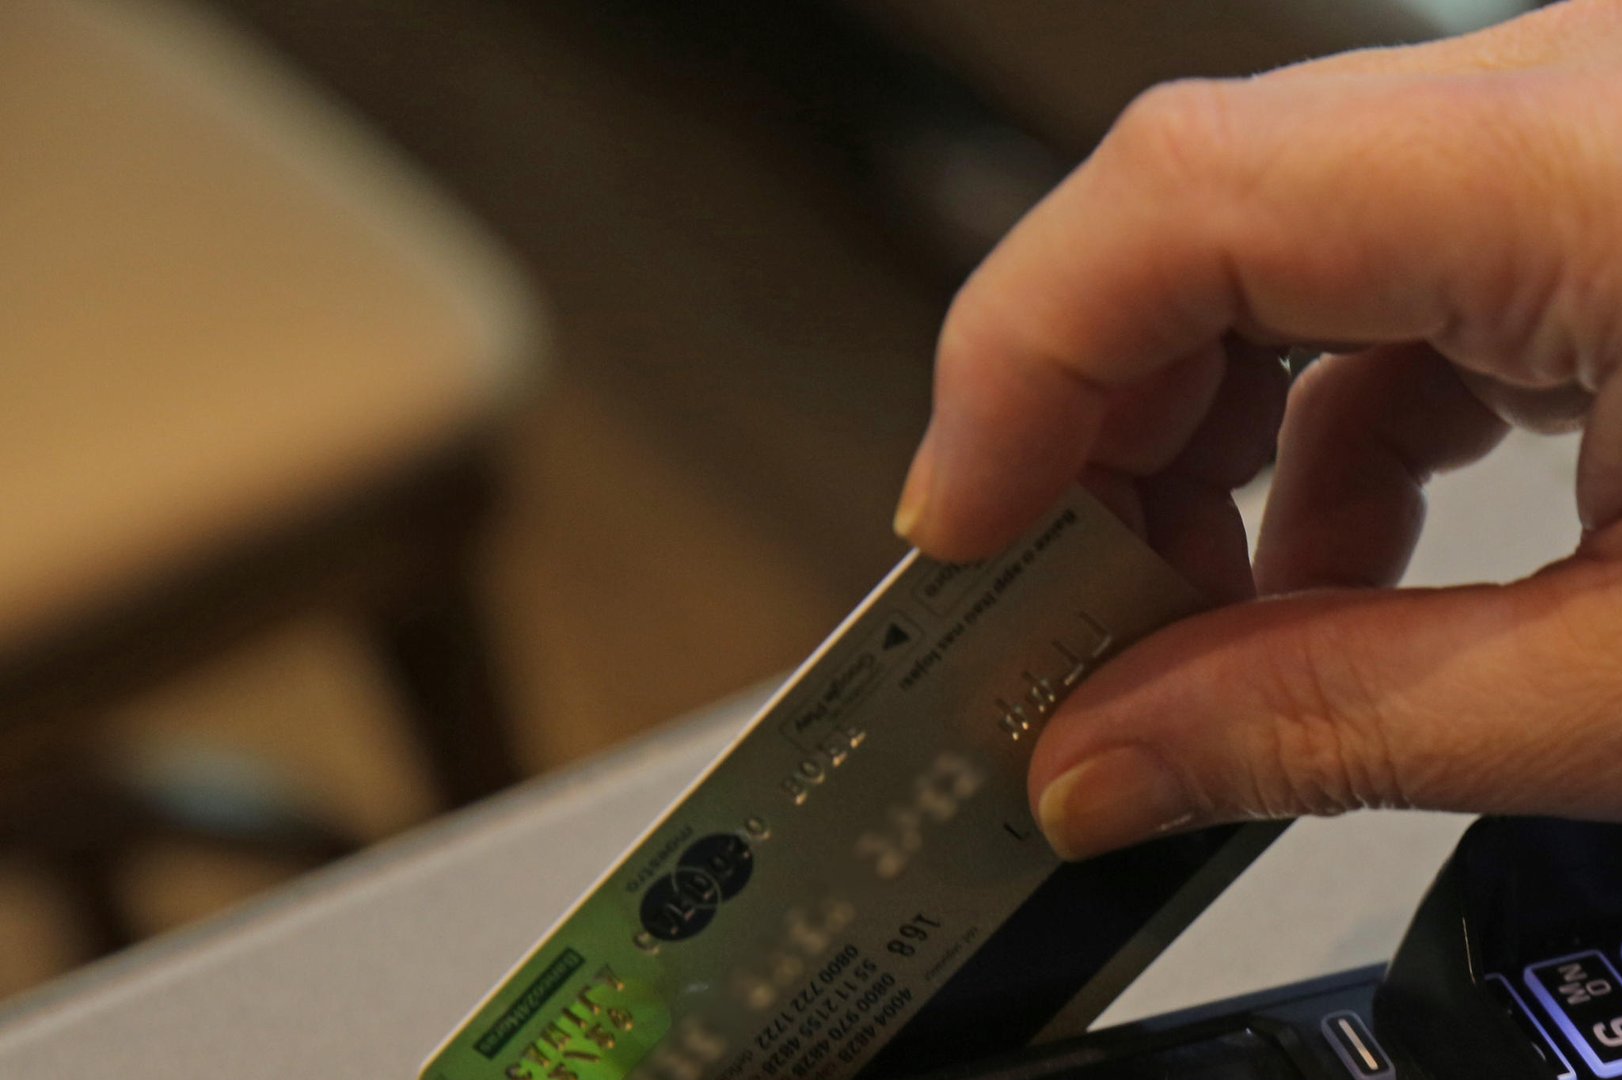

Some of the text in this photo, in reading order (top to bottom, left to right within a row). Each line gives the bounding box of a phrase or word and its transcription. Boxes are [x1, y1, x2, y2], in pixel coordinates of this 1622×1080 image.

[1031, 506, 1079, 555] Baixe
[991, 557, 1027, 593] app
[935, 621, 966, 654] nas
[790, 699, 828, 739] Play
[623, 824, 695, 896] maestro
[880, 905, 941, 965] 168
[816, 941, 860, 986] 0800
[848, 956, 877, 987] 55
[786, 978, 823, 1017] 722
[831, 979, 855, 1004] 11
[853, 970, 896, 1013] 0800
[753, 1009, 794, 1051] 1722
[794, 995, 840, 1042] 2155
[824, 1006, 860, 1043] 970
[835, 985, 914, 1065] 4004 4828
[760, 1033, 803, 1077] 4828
[788, 1034, 833, 1080] 4828
